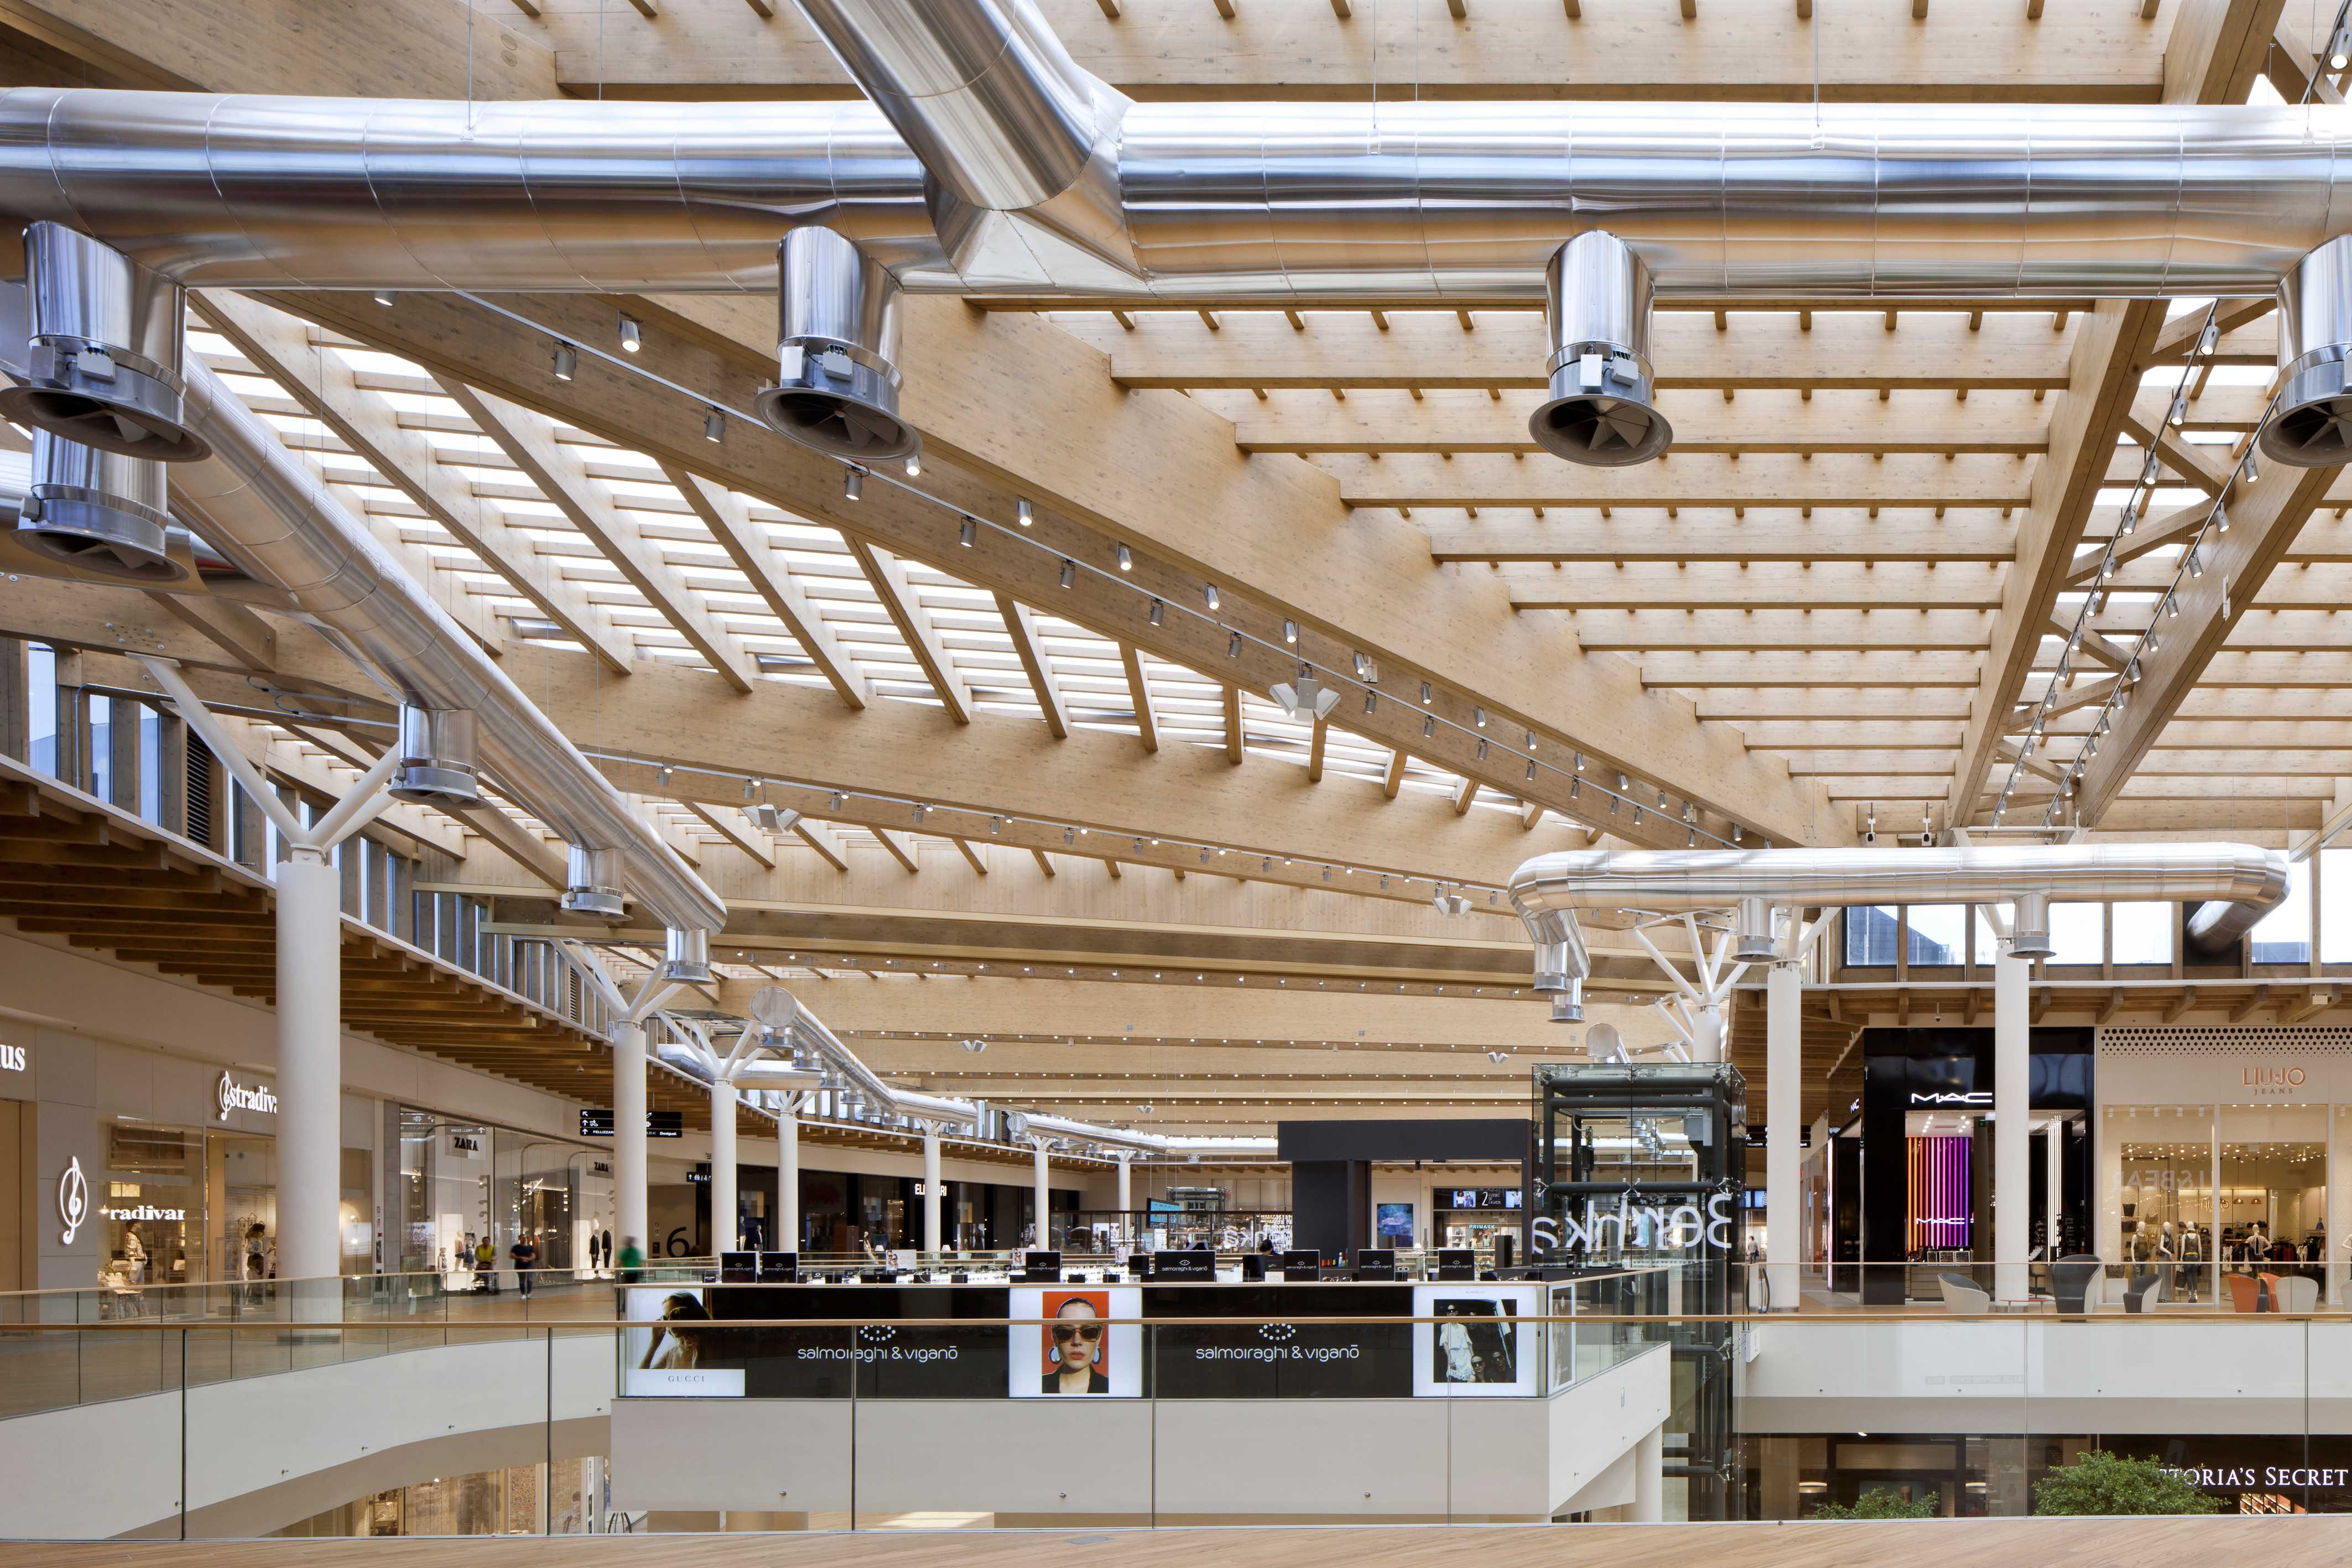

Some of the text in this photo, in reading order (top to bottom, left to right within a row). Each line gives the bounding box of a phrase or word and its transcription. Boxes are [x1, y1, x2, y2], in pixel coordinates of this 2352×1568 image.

[454, 1137, 479, 1151] ZARA
[1482, 1191, 1488, 1206] 2
[667, 1226, 690, 1258] 6
[798, 1346, 887, 1363] salmoiraghi
[891, 1346, 903, 1359] &
[1196, 1346, 1287, 1362] salmoiraghi
[1292, 1346, 1303, 1359] &
